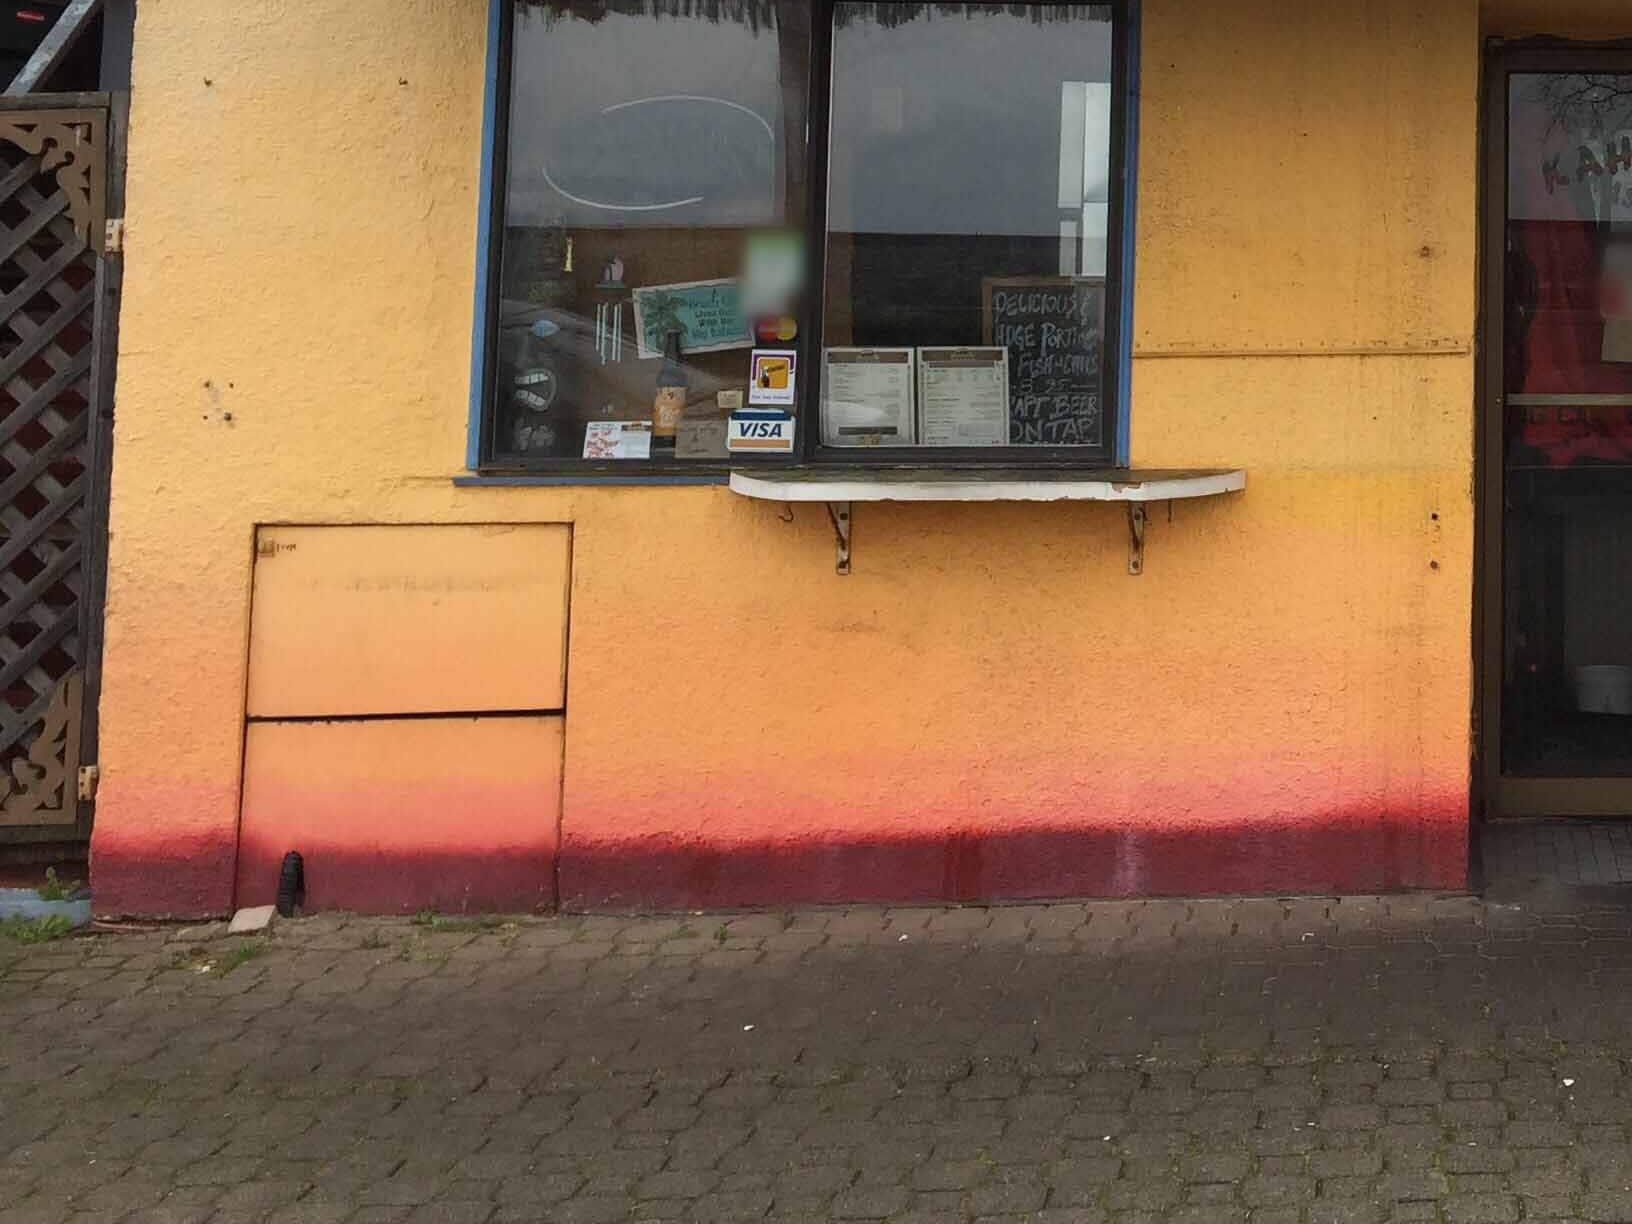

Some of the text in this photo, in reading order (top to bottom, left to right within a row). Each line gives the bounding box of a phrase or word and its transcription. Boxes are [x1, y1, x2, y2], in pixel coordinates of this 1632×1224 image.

[1050, 395, 1098, 420] BEER
[739, 422, 782, 438] VISA
[1044, 417, 1094, 441] TAP
